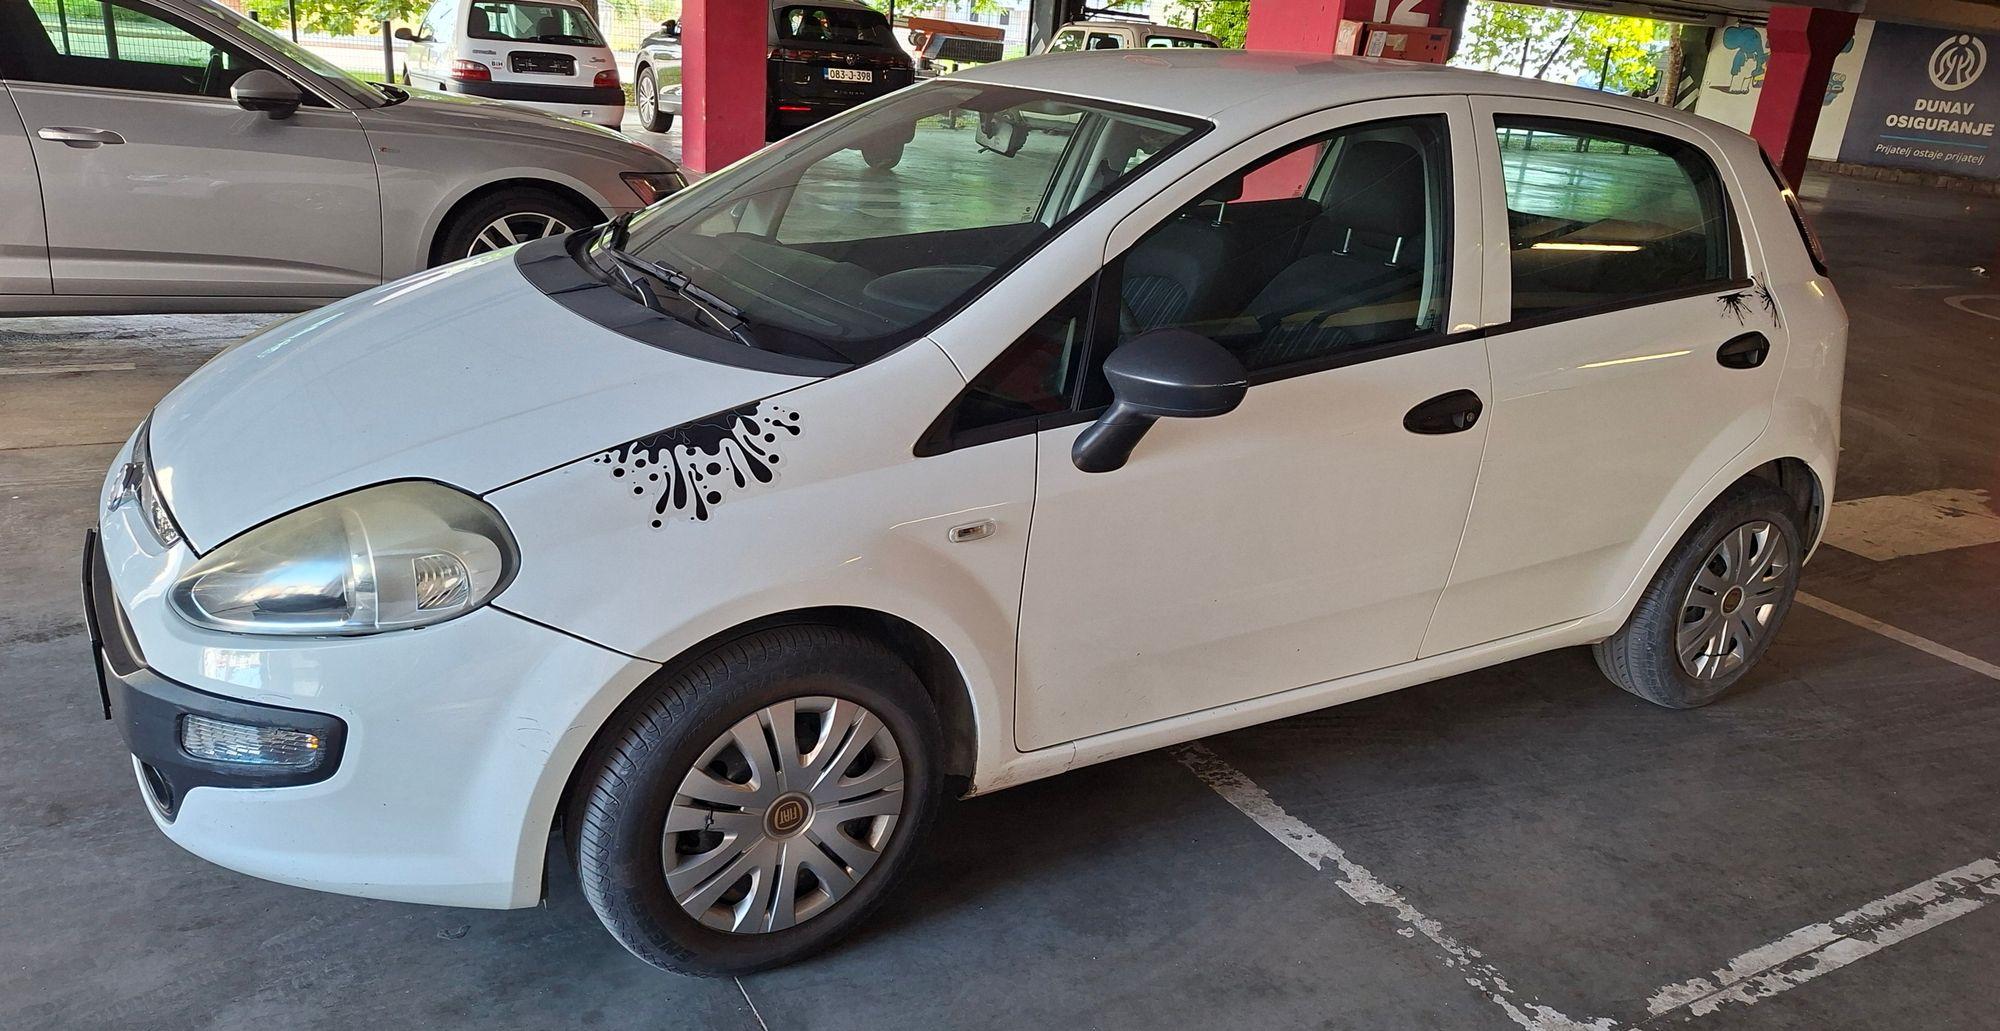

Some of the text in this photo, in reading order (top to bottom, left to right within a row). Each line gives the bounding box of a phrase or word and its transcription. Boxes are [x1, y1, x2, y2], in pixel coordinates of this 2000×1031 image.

[829, 69, 871, 81] 083-J-398
[1914, 99, 1974, 115] DUNAV
[1886, 115, 1995, 136] OSIGURANJE
[1875, 144, 1985, 165] Prijatelj ostaje prijatelj
[780, 806, 797, 824] FIAT
